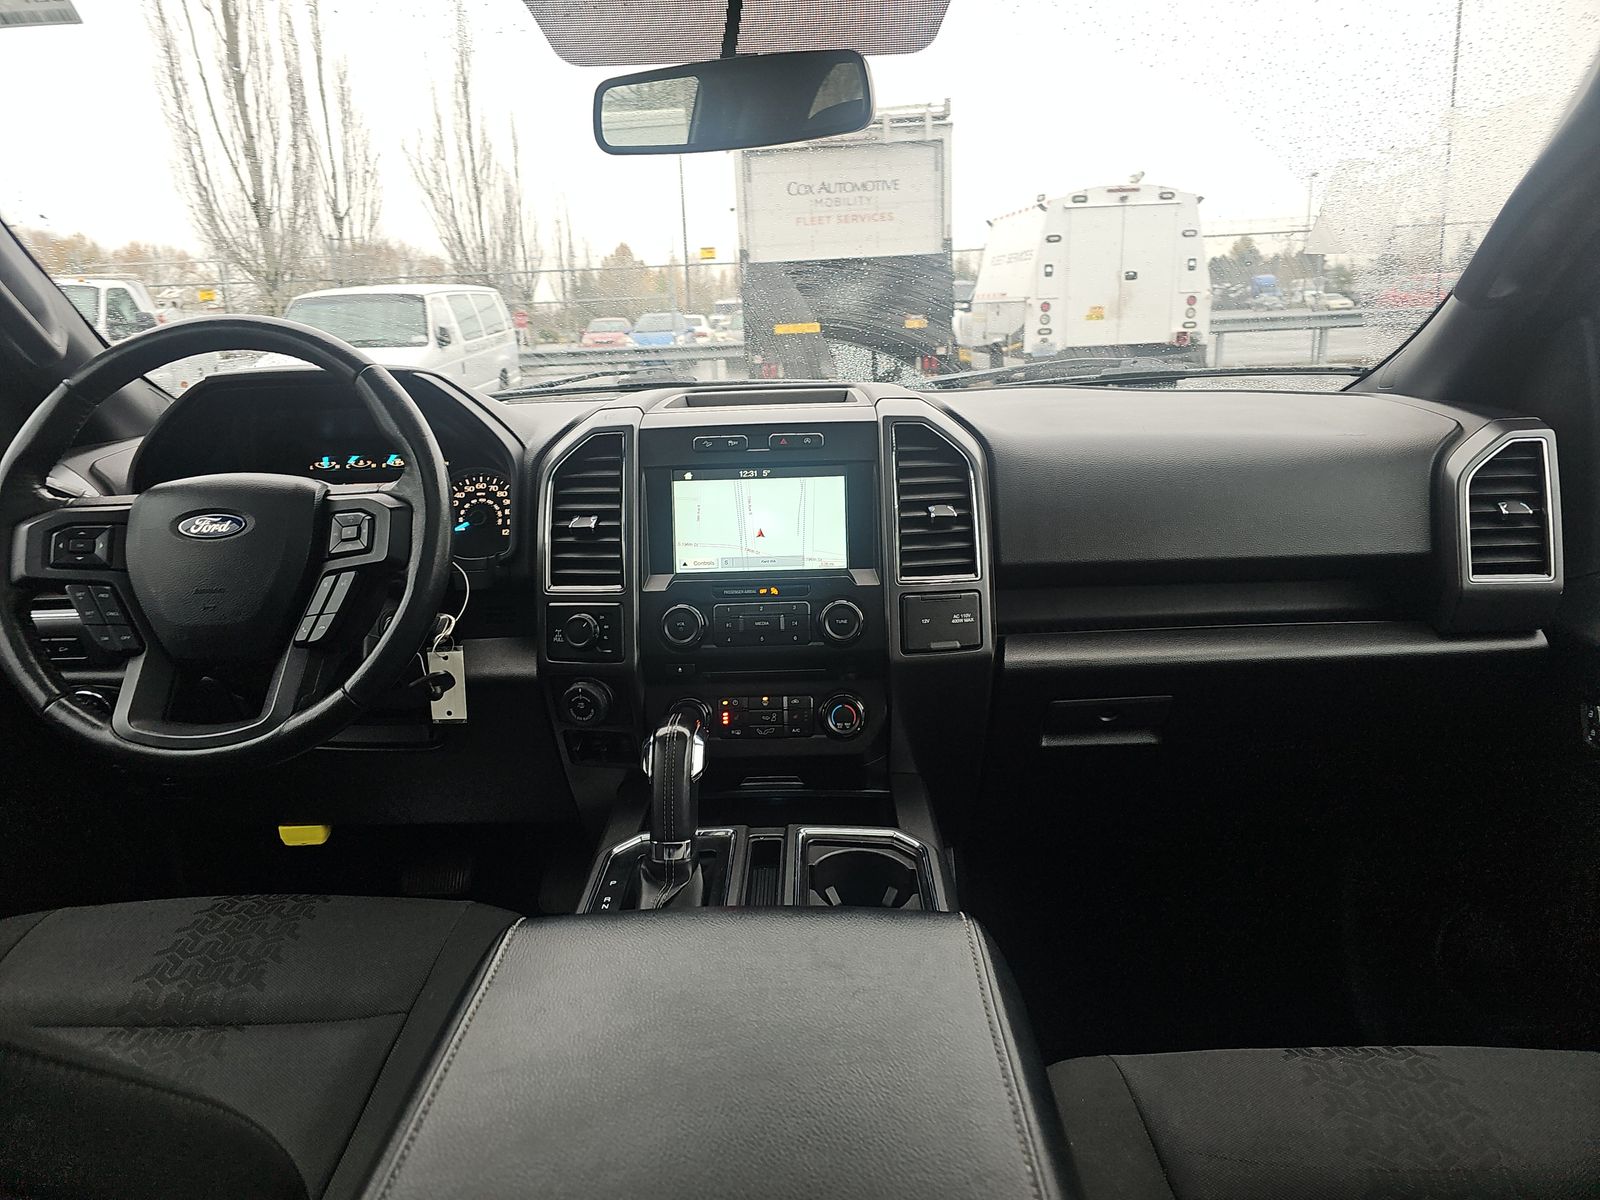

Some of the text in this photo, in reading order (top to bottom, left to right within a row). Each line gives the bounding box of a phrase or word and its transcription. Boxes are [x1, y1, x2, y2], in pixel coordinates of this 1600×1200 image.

[814, 195, 872, 208] MOBILITY
[796, 211, 895, 226] FLEET SERVICES
[739, 469, 758, 478] 12:31
[475, 482, 487, 490] 60
[496, 490, 508, 498] 80
[190, 517, 232, 533] Ford
